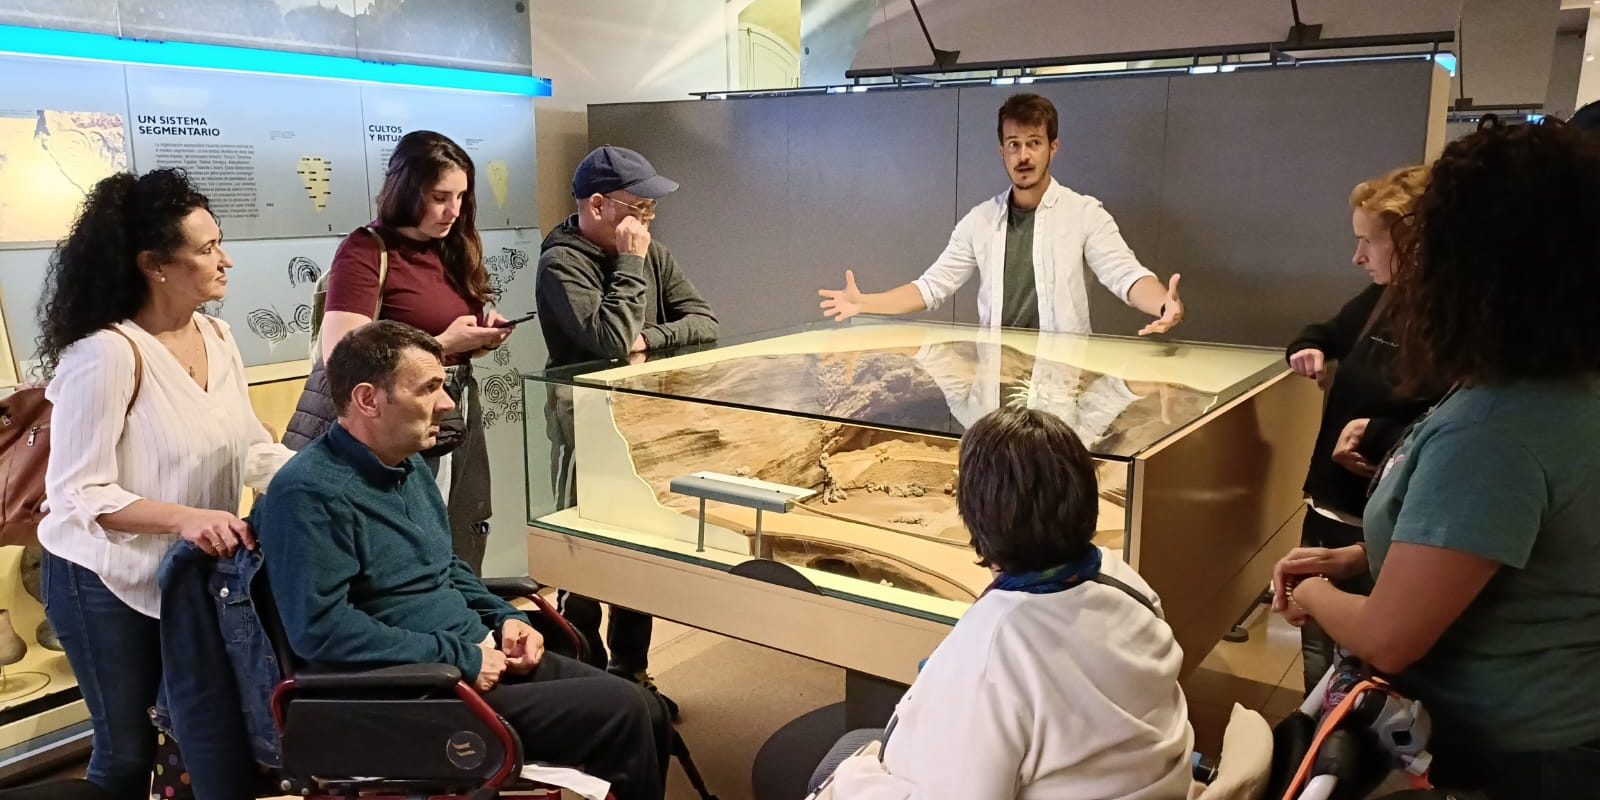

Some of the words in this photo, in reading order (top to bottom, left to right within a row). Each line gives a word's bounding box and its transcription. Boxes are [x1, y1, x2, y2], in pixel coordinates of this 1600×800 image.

[137, 115, 156, 124] UN
[160, 115, 208, 126] SISTEMA
[139, 125, 220, 136] SEGMENTARIO
[368, 124, 402, 133] CULTOS
[369, 133, 375, 141] Y
